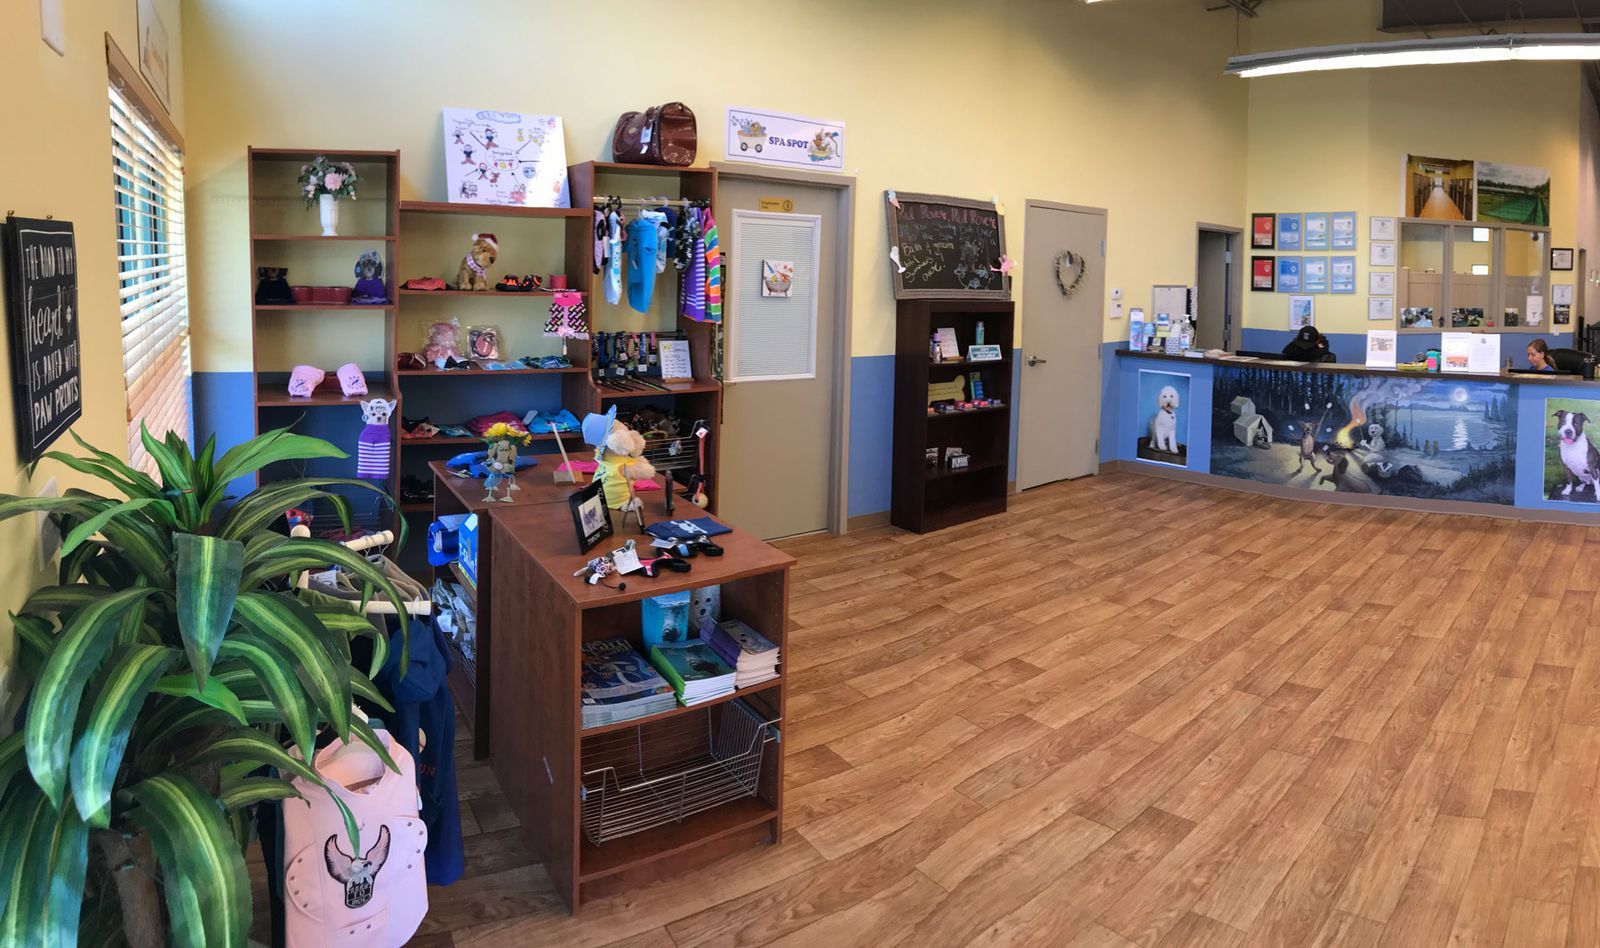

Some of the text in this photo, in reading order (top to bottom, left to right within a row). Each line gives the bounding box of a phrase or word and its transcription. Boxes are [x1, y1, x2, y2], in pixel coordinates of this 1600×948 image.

[769, 136, 808, 149] SPA SPOT
[25, 244, 39, 280] THE
[56, 246, 64, 276] TO
[64, 245, 74, 276] MY
[27, 285, 63, 352] heart
[33, 360, 41, 392] IS
[63, 341, 77, 373] WITH
[34, 376, 79, 432] PAW PRINTS
